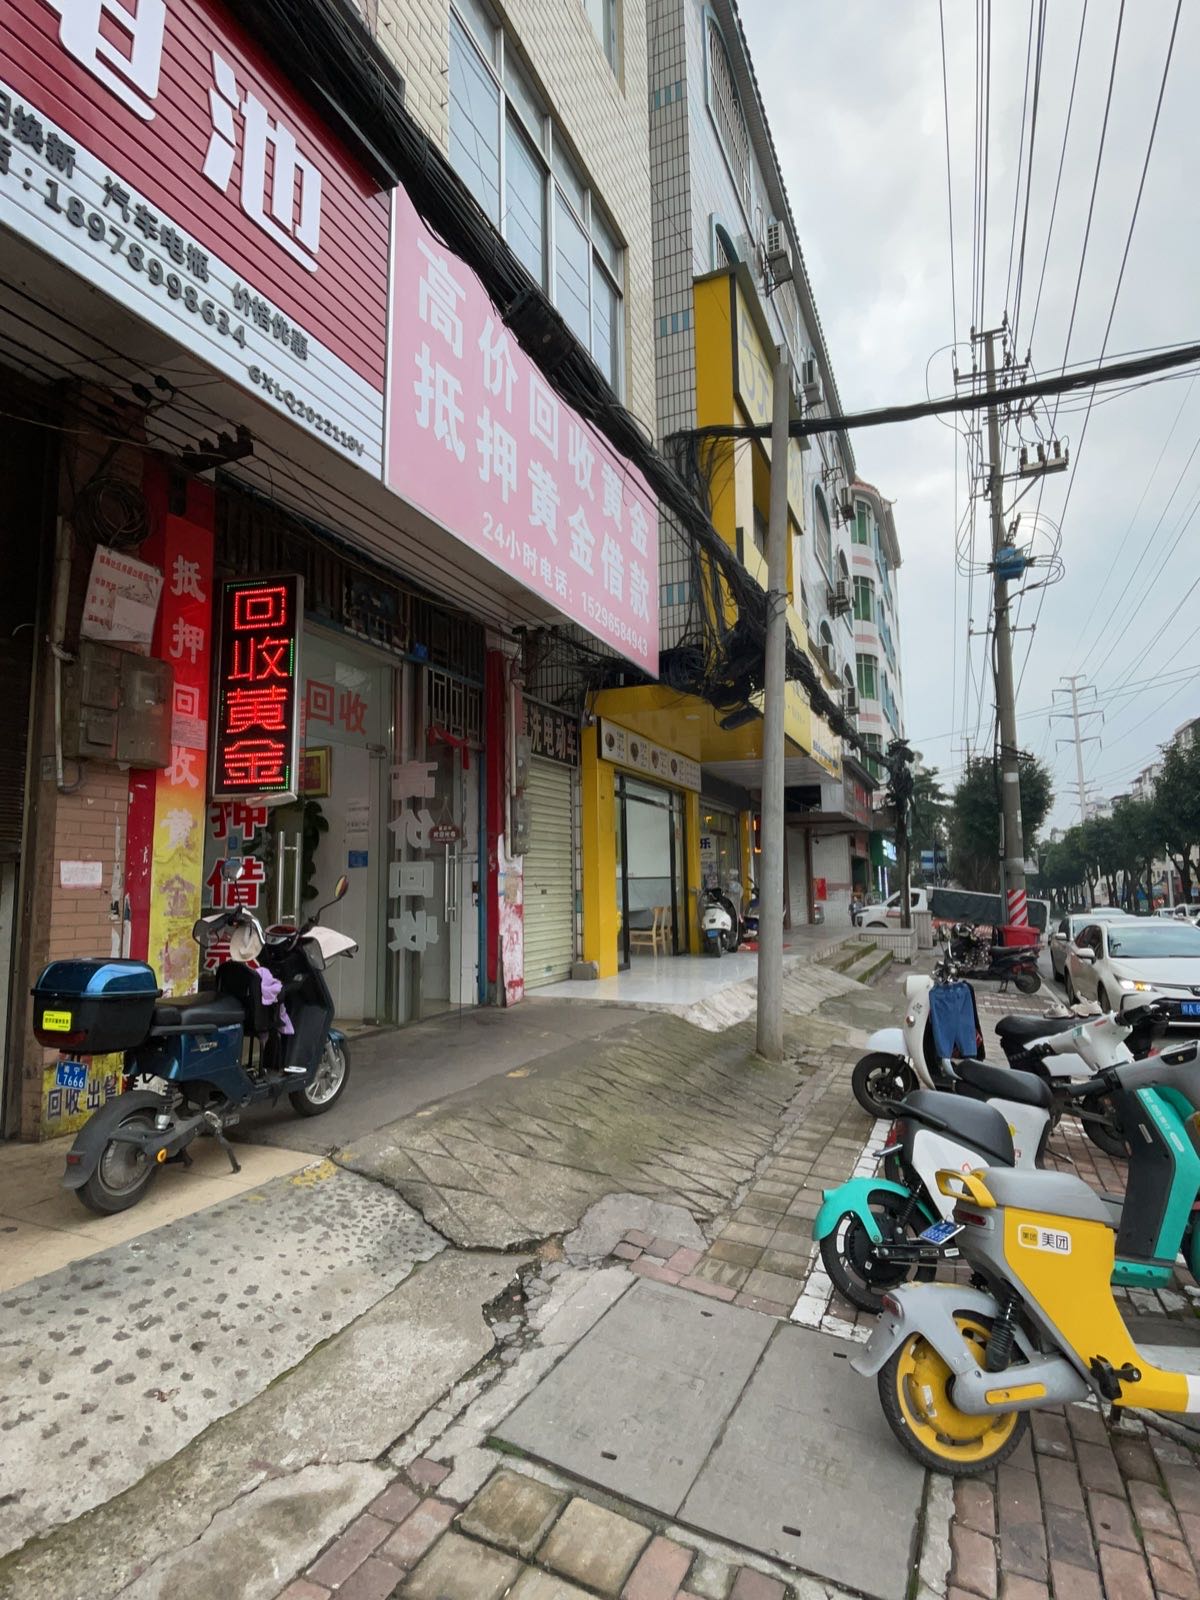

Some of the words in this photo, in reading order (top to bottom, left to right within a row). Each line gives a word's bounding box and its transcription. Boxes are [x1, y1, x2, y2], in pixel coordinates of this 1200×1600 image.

[103, 175, 209, 283] 汽车电瓶
[231, 282, 308, 361] 价格优惠
[412, 342, 650, 625] 抵押黄金借款
[416, 238, 649, 560] 高价回收黄金
[223, 586, 290, 786] 回收黄金
[306, 679, 369, 737] 回收
[520, 702, 577, 769] 洗电动车
[1041, 1232, 1069, 1251] 美团
